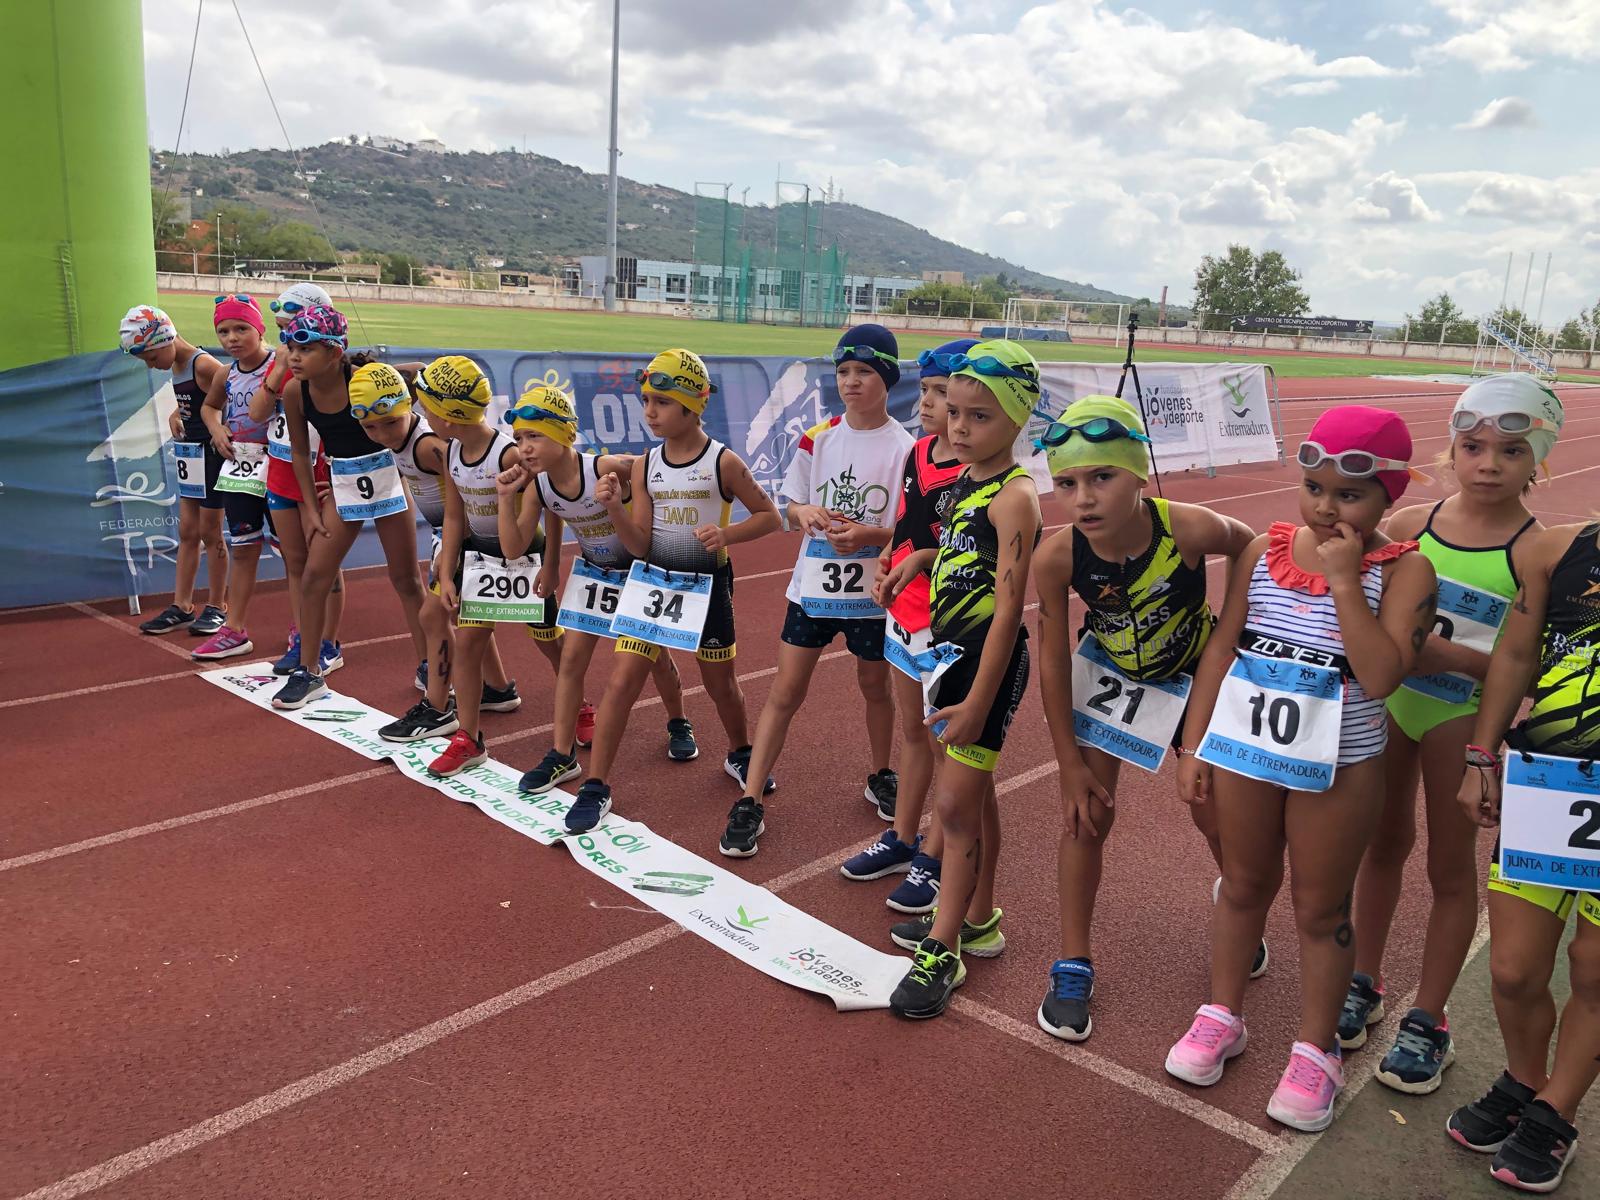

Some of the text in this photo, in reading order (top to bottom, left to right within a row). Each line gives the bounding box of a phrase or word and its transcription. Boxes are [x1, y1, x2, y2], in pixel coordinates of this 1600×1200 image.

[1146, 387, 1193, 417] jóvenes
[1164, 411, 1204, 428] ydeporte
[1219, 420, 1270, 437] Extremadura
[356, 475, 375, 500] 9
[663, 506, 699, 526] DAVID
[477, 574, 530, 599] 290
[822, 562, 864, 593] 32
[465, 605, 540, 616] JUNTA DE EXTREMADURA
[584, 582, 620, 615] 15
[643, 589, 684, 624] 34
[804, 600, 822, 609] JUNTA
[825, 601, 833, 609] DE
[577, 615, 586, 624] DE
[616, 617, 697, 643] JUNTA DE EXTREMADURA
[1086, 675, 1146, 725] 21
[1248, 691, 1301, 746] 10
[1094, 727, 1159, 761] EXTREMADURA
[1206, 738, 1328, 781] JUNTA DE EXTREMADURA
[1507, 854, 1543, 872] JUNTA
[1551, 861, 1566, 874] DE
[688, 907, 760, 952] Extremadura
[789, 947, 863, 988] jóvenes
